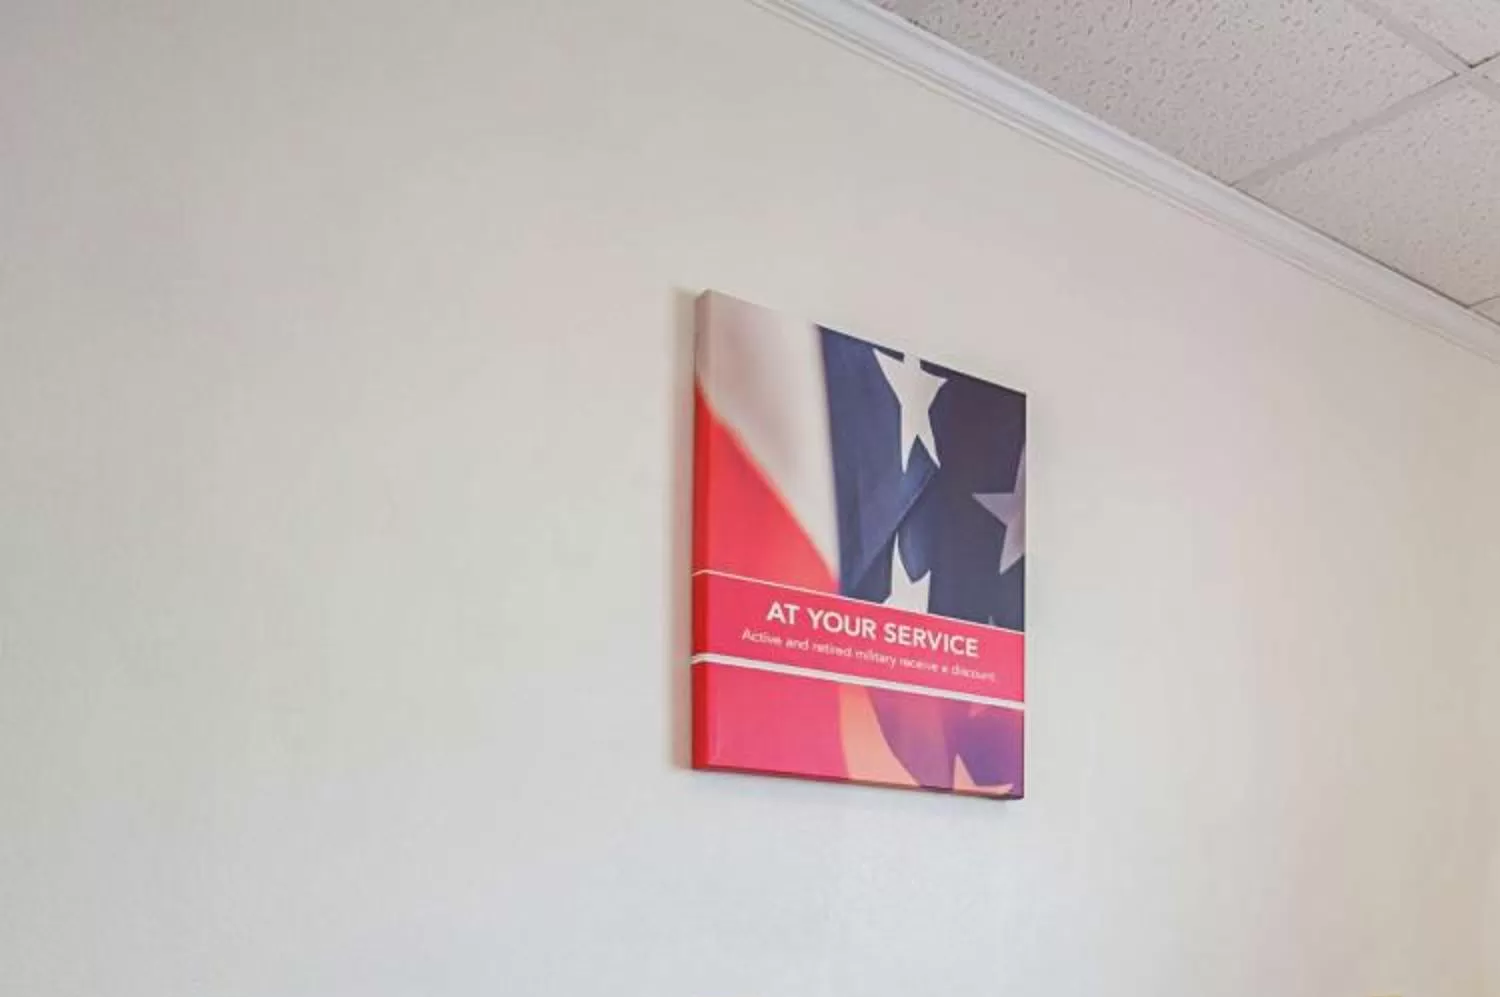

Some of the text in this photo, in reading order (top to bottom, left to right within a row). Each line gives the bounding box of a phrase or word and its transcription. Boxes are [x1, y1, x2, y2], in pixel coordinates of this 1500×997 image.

[741, 627, 782, 647] Active
[784, 637, 809, 652] and
[812, 642, 853, 658] retired
[855, 649, 897, 669] military
[766, 600, 979, 658] AT YOUR SERVICE
